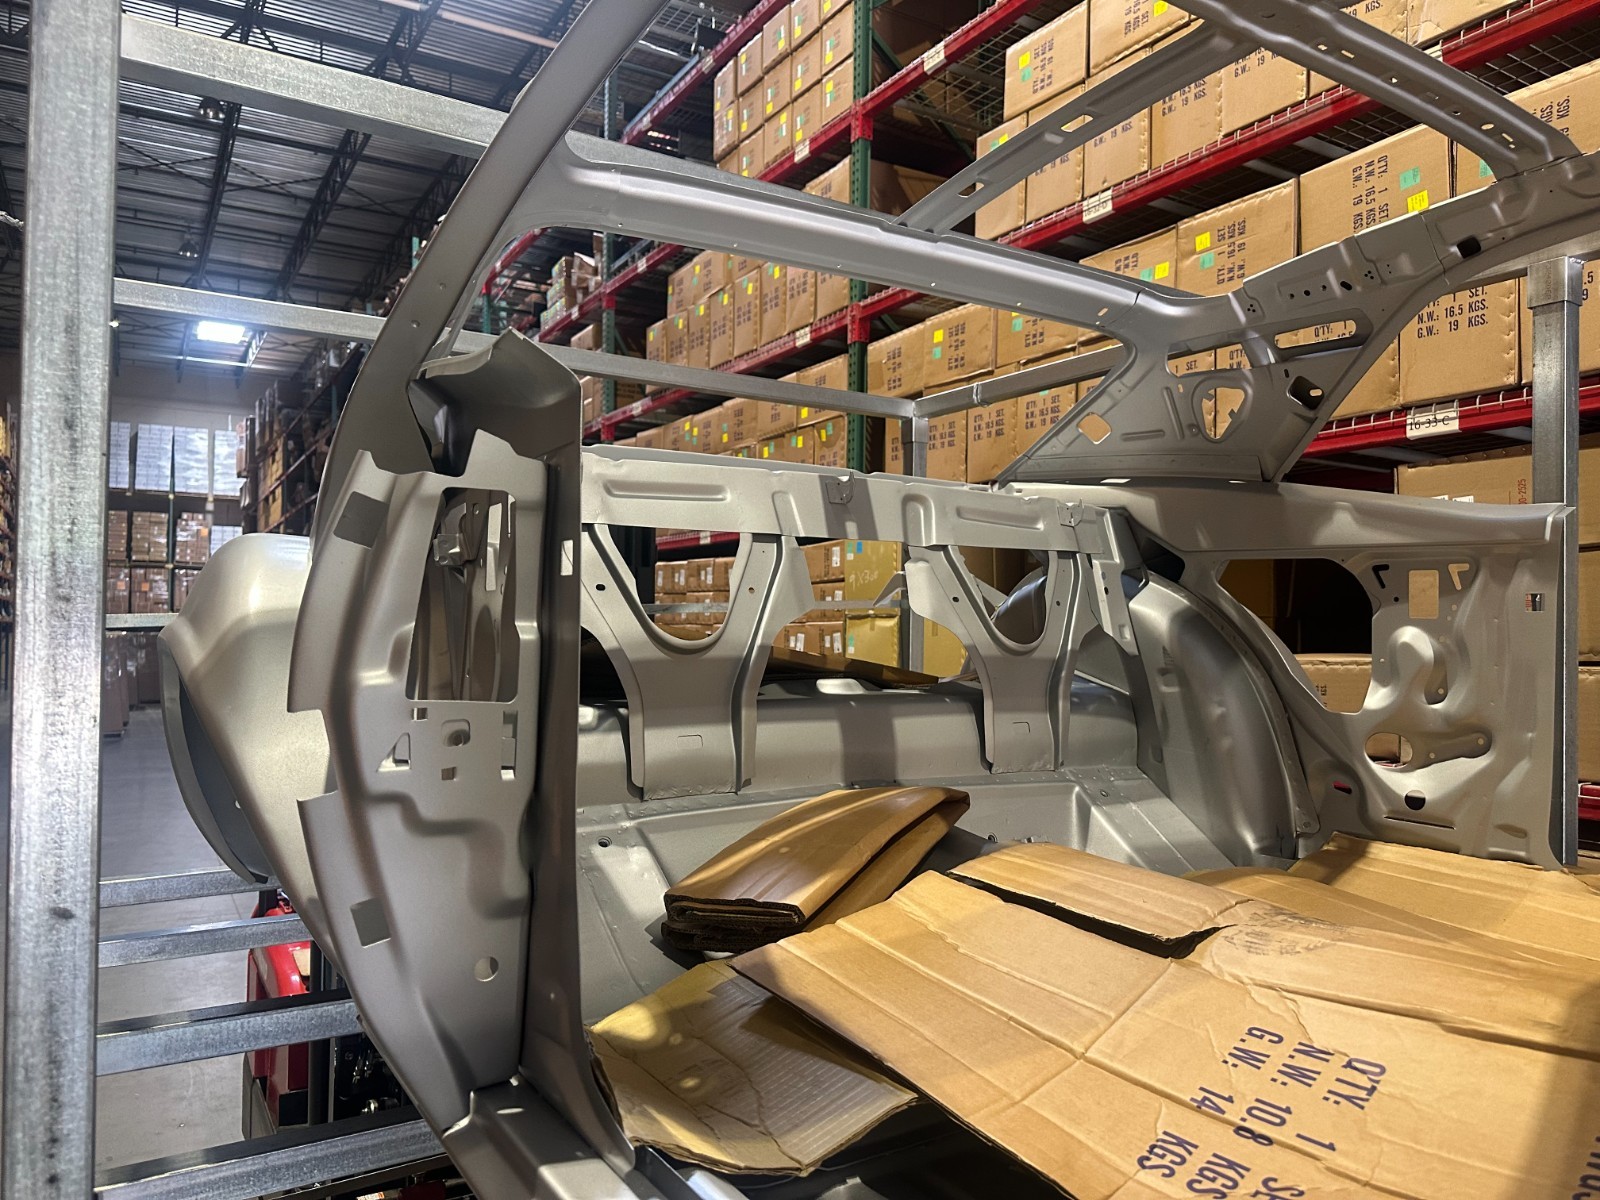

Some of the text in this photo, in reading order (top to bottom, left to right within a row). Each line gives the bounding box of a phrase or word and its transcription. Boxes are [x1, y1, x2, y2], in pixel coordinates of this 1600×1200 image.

[1257, 55, 1265, 66] 19
[1557, 95, 1570, 120] KGS.
[1377, 155, 1388, 178] Q'TY:
[1352, 166, 1363, 233] G.W.: 19 KGS.
[1365, 160, 1376, 228] N.W.: 16.5 KGS.
[1379, 203, 1388, 222] SET.
[1217, 226, 1226, 242] SET.
[1237, 217, 1246, 278] G.W.: 19 KGS.
[1217, 264, 1225, 285] Q'TY:
[1227, 262, 1235, 282] N.W.:
[1417, 310, 1439, 324] N.W.:
[1444, 304, 1463, 318] 16.5
[1468, 299, 1489, 313] KGS.
[1315, 324, 1332, 337] Q'TY:
[1417, 314, 1489, 339] G.W.: 19 KGS.
[1409, 415, 1449, 430] 16-33-C
[1322, 1057, 1386, 1111] Q'TY:
[1189, 1086, 1235, 1115] 14
[1233, 1098, 1293, 1146] 10.8
[1137, 1130, 1199, 1178] KGS
[1296, 1133, 1336, 1151] 1
[1186, 1152, 1252, 1200] KGS
